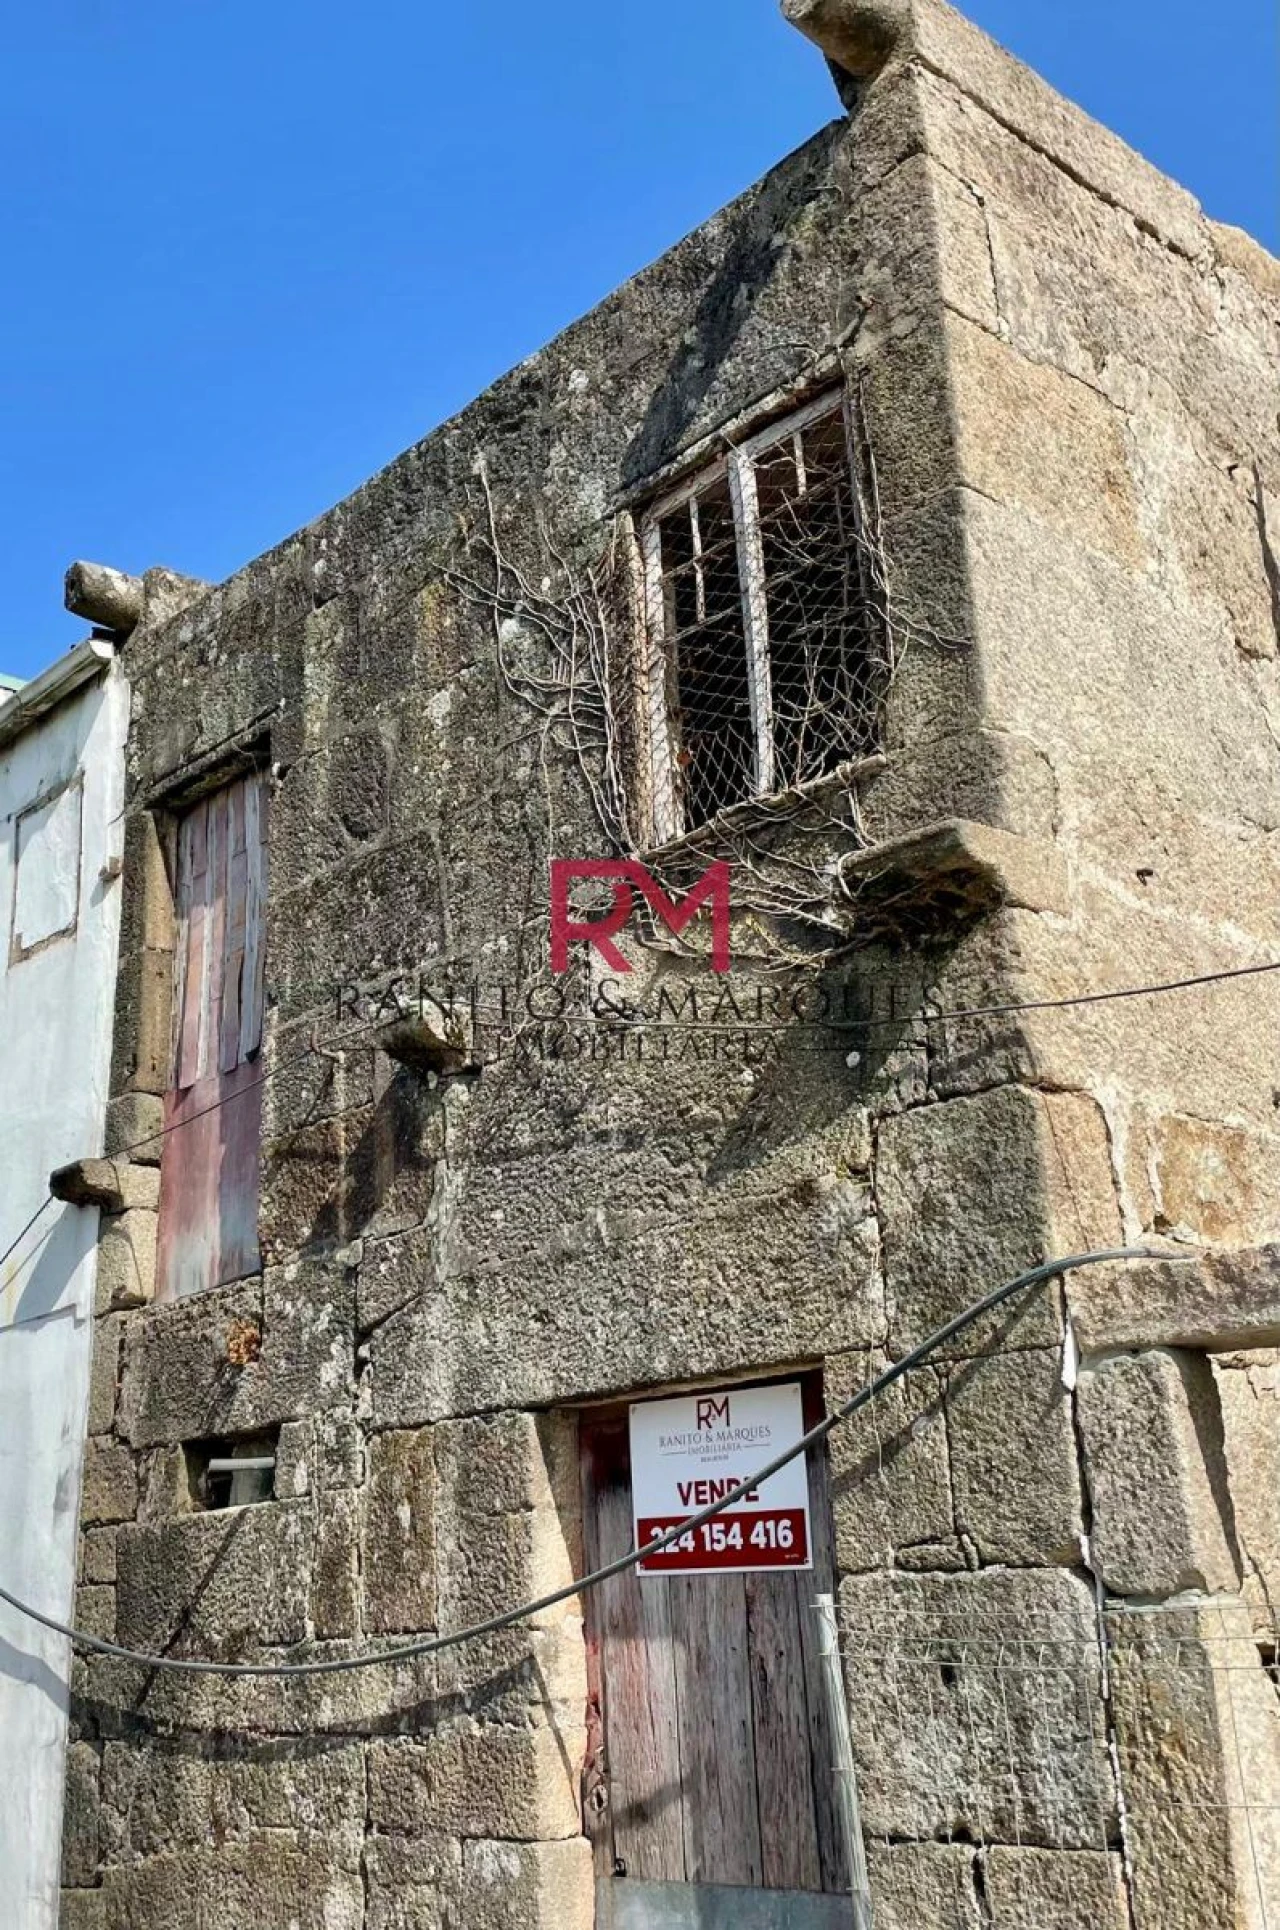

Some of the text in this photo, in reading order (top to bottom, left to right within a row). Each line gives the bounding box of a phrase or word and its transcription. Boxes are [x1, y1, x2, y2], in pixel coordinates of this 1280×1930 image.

[659, 1425, 771, 1448] RANITO & MARQUES
[701, 1521, 743, 1552] 154
[750, 1517, 794, 1548] 416
